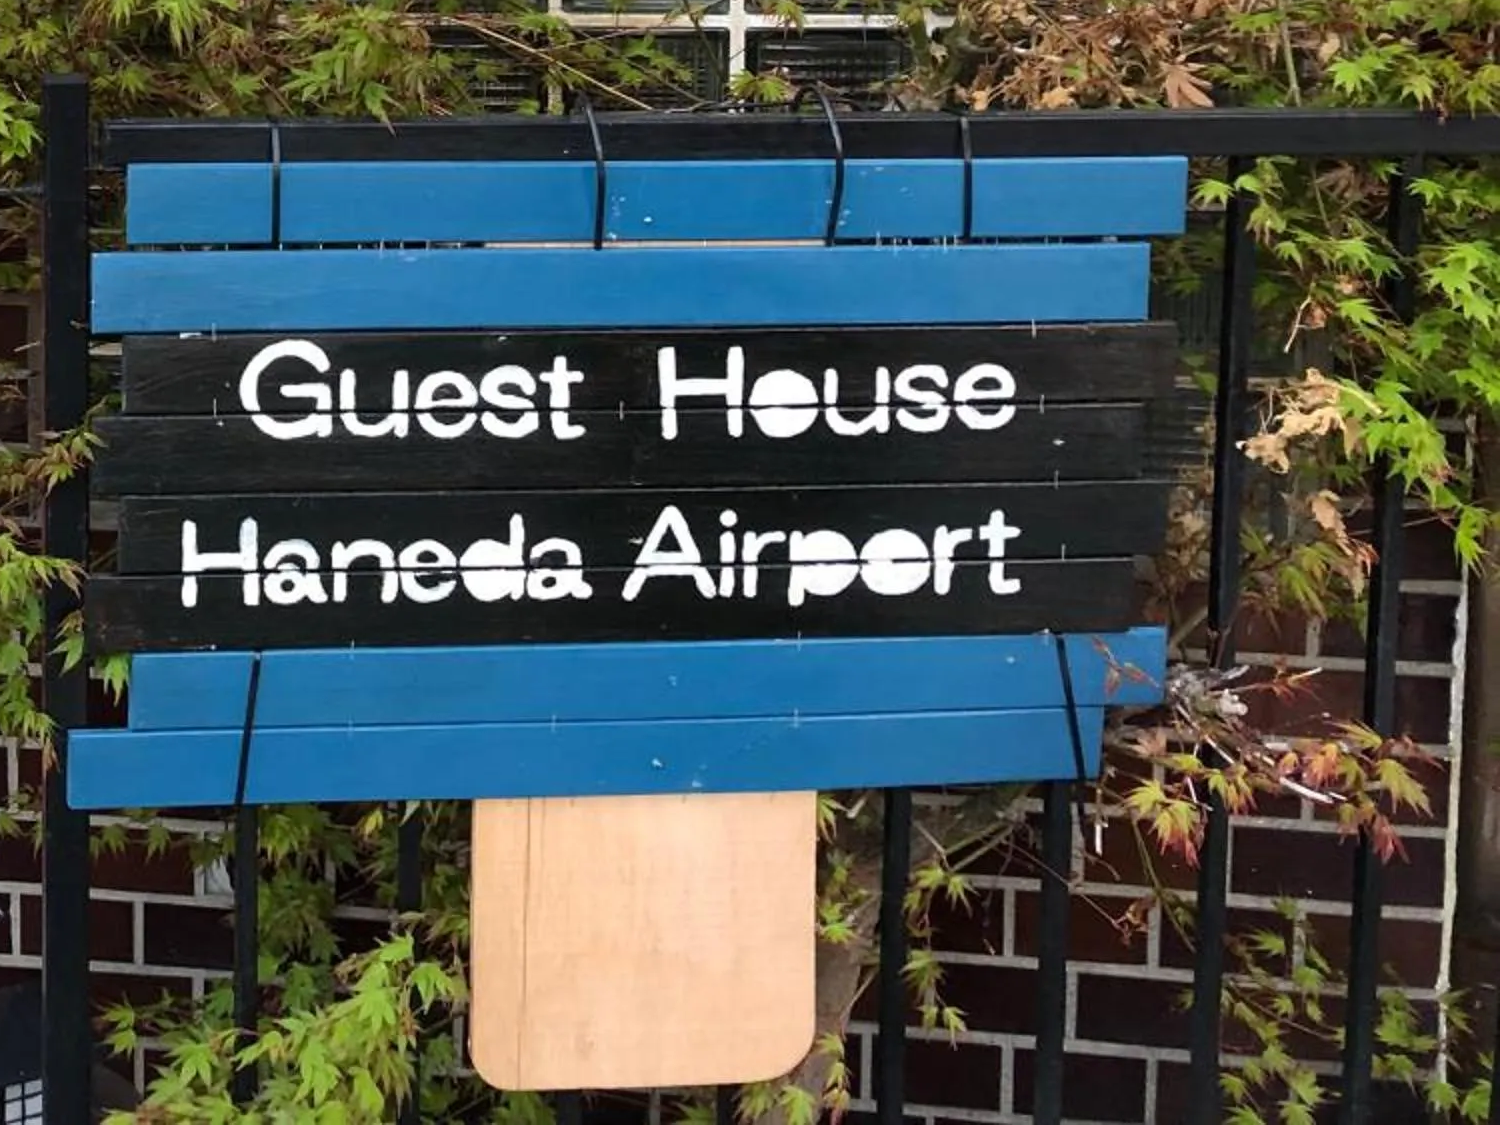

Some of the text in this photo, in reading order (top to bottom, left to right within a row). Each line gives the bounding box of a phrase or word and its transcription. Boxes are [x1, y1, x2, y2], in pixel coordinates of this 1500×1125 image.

[238, 339, 1016, 440] Guest House
[181, 505, 1021, 608] Haneda Airport
